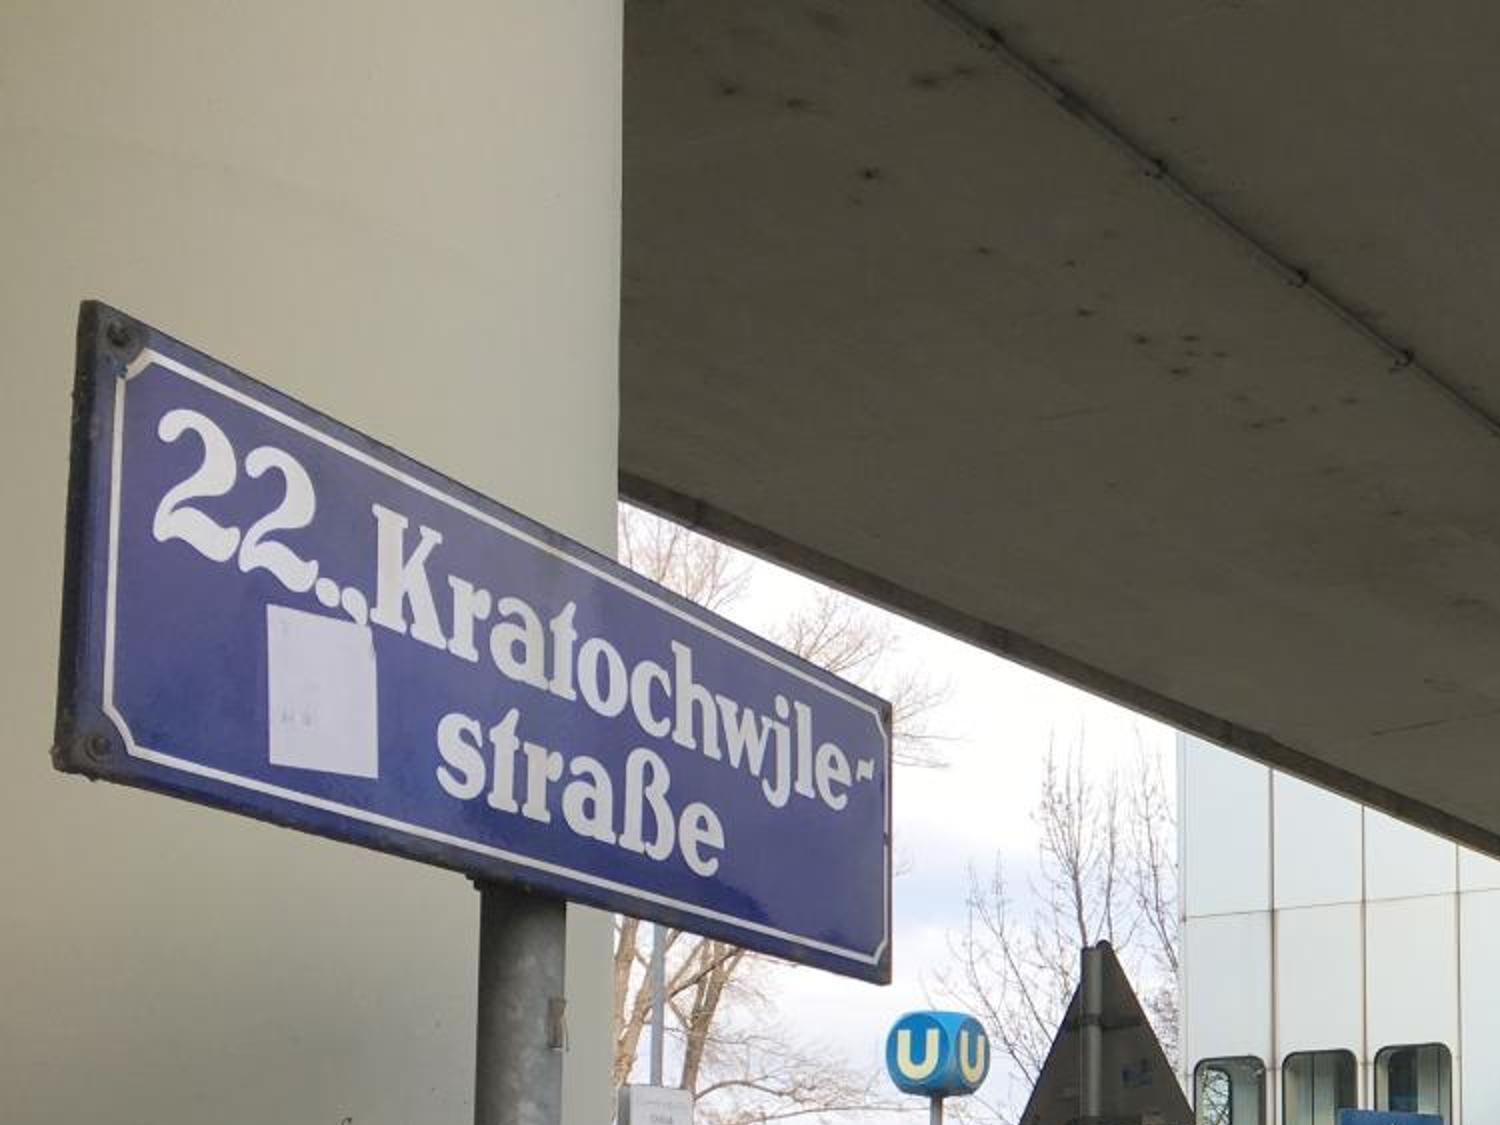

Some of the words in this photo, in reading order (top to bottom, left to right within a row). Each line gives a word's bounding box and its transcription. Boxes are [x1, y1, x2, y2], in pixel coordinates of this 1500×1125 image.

[371, 502, 876, 811] Kratochwjle-
[435, 707, 726, 877] straße
[897, 1028, 939, 1079] U
[960, 1029, 985, 1082] U
